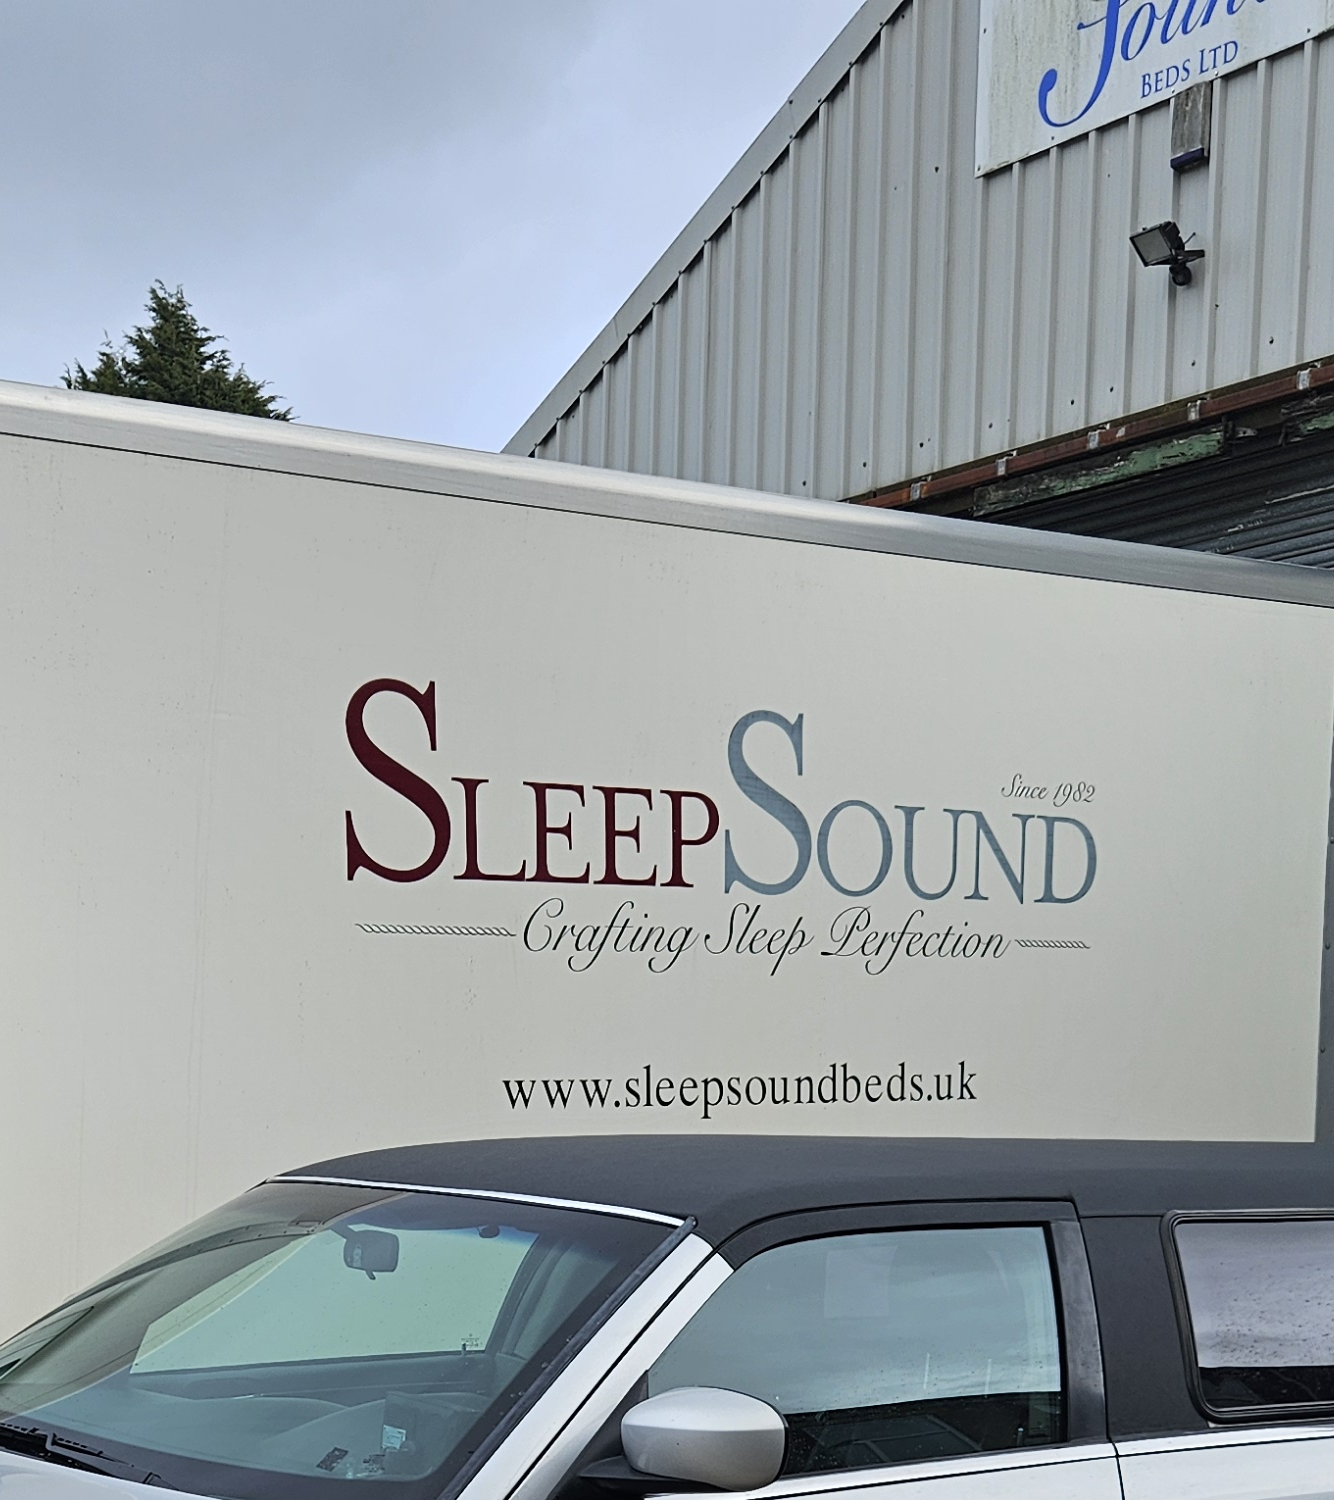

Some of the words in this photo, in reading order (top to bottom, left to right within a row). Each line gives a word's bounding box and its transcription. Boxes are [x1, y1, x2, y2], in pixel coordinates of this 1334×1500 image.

[1140, 58, 1191, 99] BEDS
[1198, 40, 1239, 75] LTD
[1001, 773, 1048, 799] Since
[1052, 781, 1095, 808] 1982
[523, 897, 698, 973] Crafting
[703, 903, 814, 977] Sleep
[820, 905, 1010, 976] Perfection
[502, 1061, 978, 1120] www.sleepsoundbeds.uk
